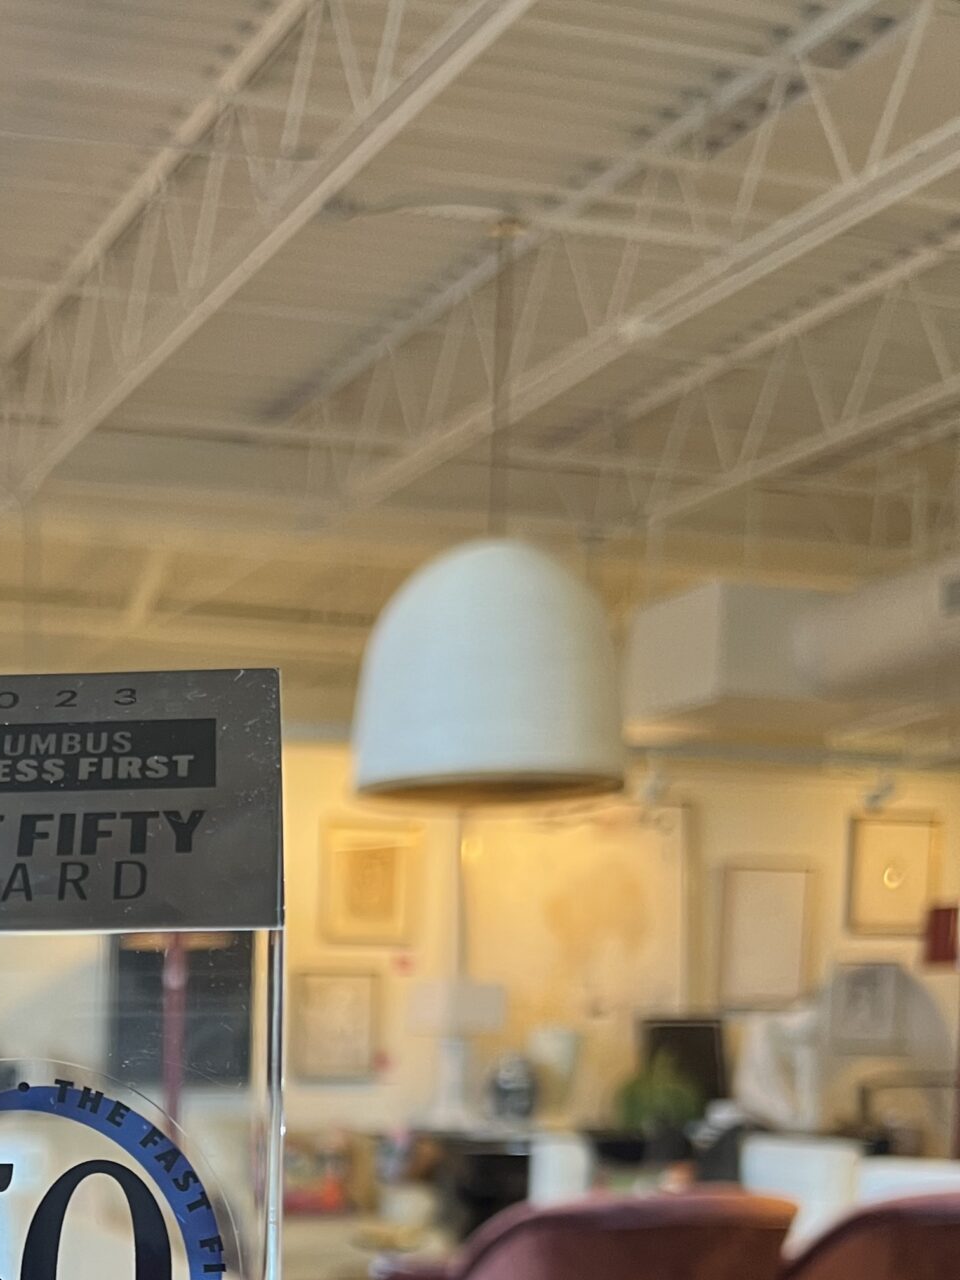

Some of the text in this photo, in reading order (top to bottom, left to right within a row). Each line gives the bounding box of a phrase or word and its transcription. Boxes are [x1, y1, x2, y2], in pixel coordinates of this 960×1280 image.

[77, 754, 195, 782] FIRST
[15, 810, 206, 857] FIFTY
[54, 1078, 131, 1128] THE
[139, 1128, 213, 1216] FAST
